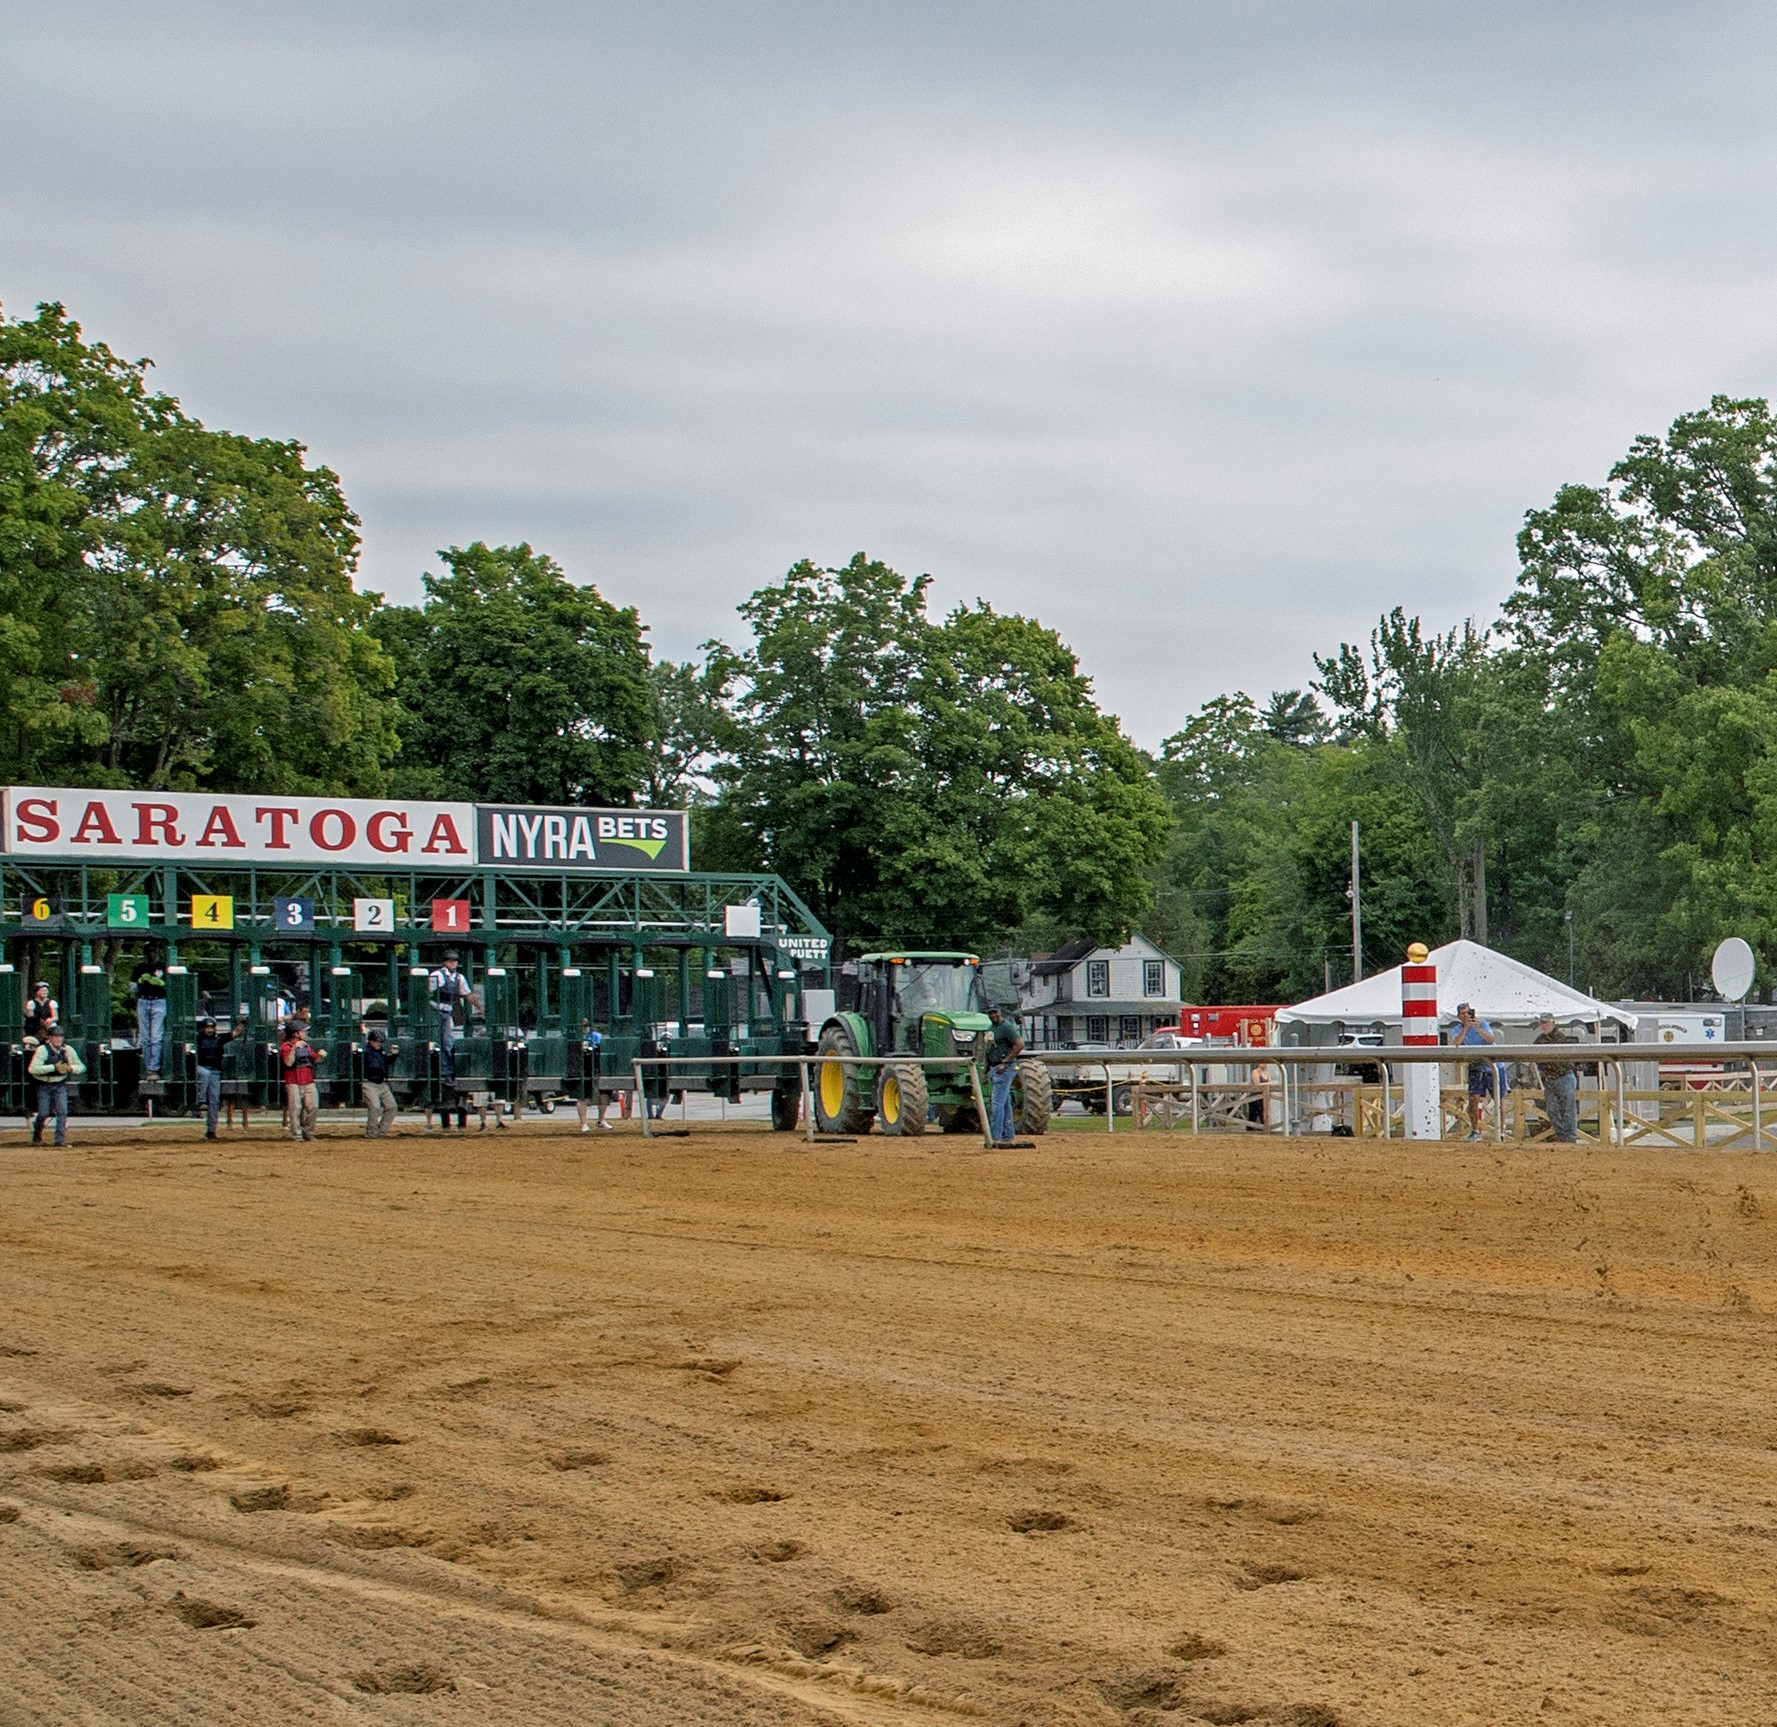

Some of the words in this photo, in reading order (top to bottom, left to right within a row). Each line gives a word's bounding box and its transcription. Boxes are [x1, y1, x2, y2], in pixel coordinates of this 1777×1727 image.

[16, 798, 468, 854] SARATOGA
[492, 813, 596, 860] NYRA
[598, 816, 669, 840] BETS
[32, 897, 51, 921] 6
[120, 899, 138, 922] 5
[204, 901, 220, 923] 4
[286, 902, 303, 926] 3
[368, 904, 382, 926] 2
[446, 904, 458, 927] 1
[778, 938, 828, 948] UNITED
[790, 949, 829, 960] PUETT
